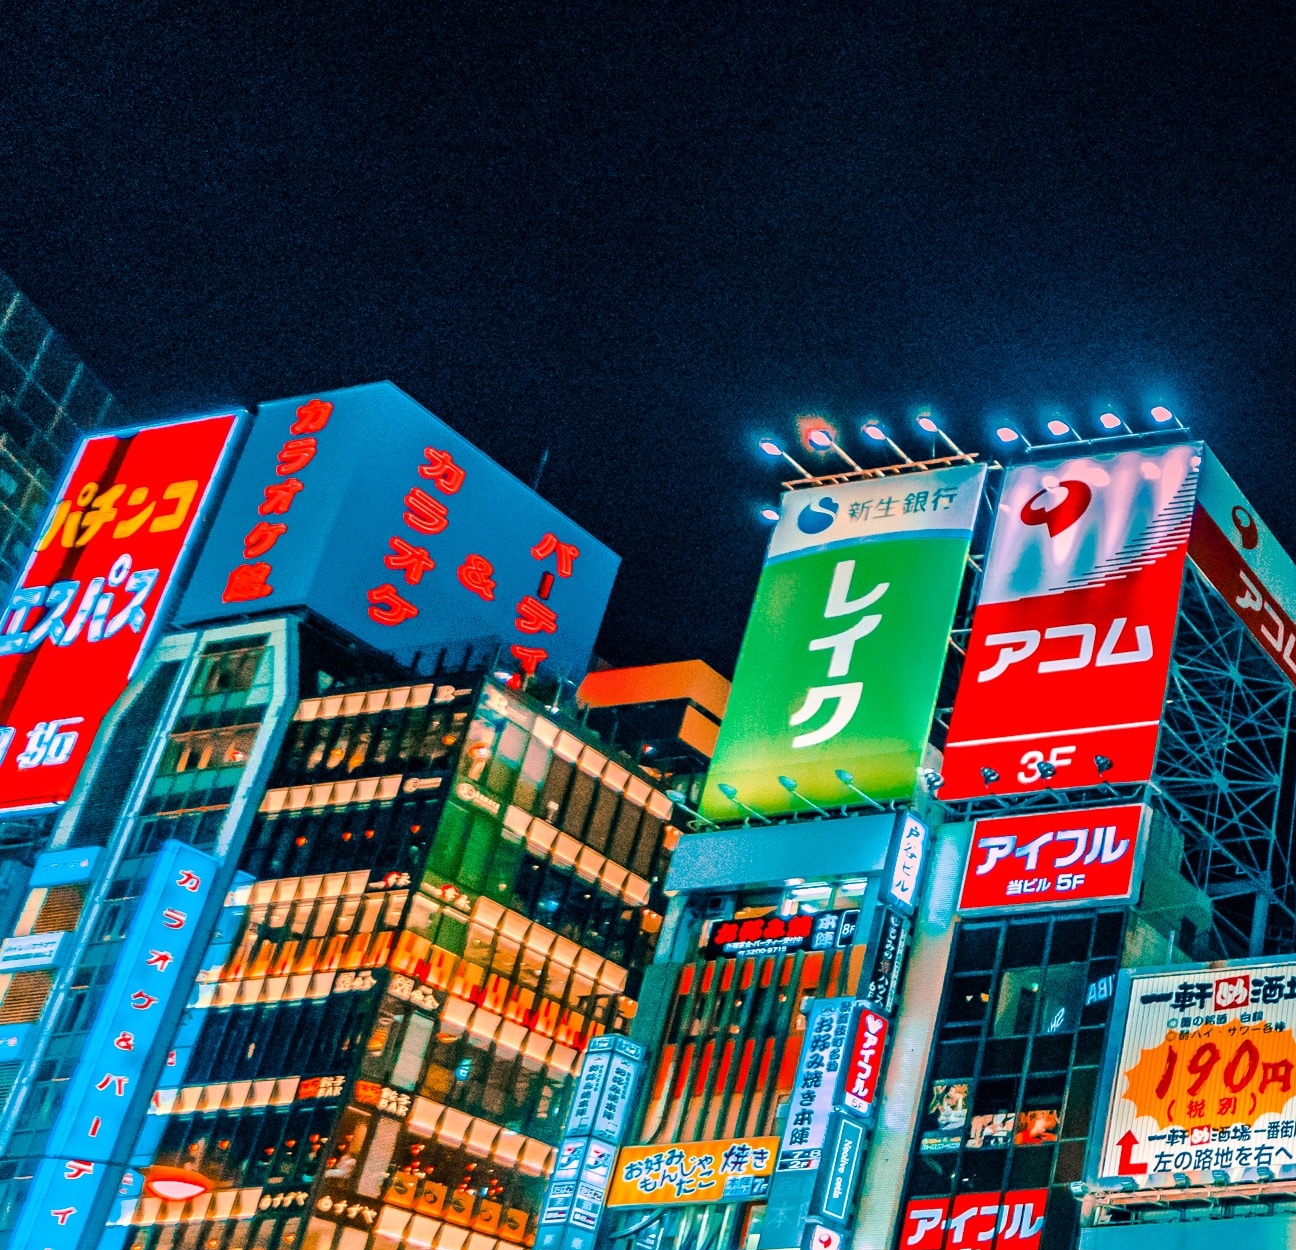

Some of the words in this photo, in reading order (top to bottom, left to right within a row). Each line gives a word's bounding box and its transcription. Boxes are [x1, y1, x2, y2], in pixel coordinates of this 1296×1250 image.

[35, 481, 198, 552] パチンコ
[848, 487, 958, 522] 新生銀行
[367, 447, 465, 625] カラオケ
[790, 560, 889, 749] レイク
[977, 617, 1154, 684] アコム
[975, 826, 1131, 875] アイフル
[1005, 877, 1052, 897] 当ビル
[1055, 872, 1085, 893] 5F
[1155, 1039, 1295, 1099] 190円
[623, 1148, 685, 1181] お好み
[719, 1144, 770, 1173] 焼き
[1153, 1144, 1293, 1173] 左の路地を右へ
[906, 1203, 1044, 1246] アイフル
